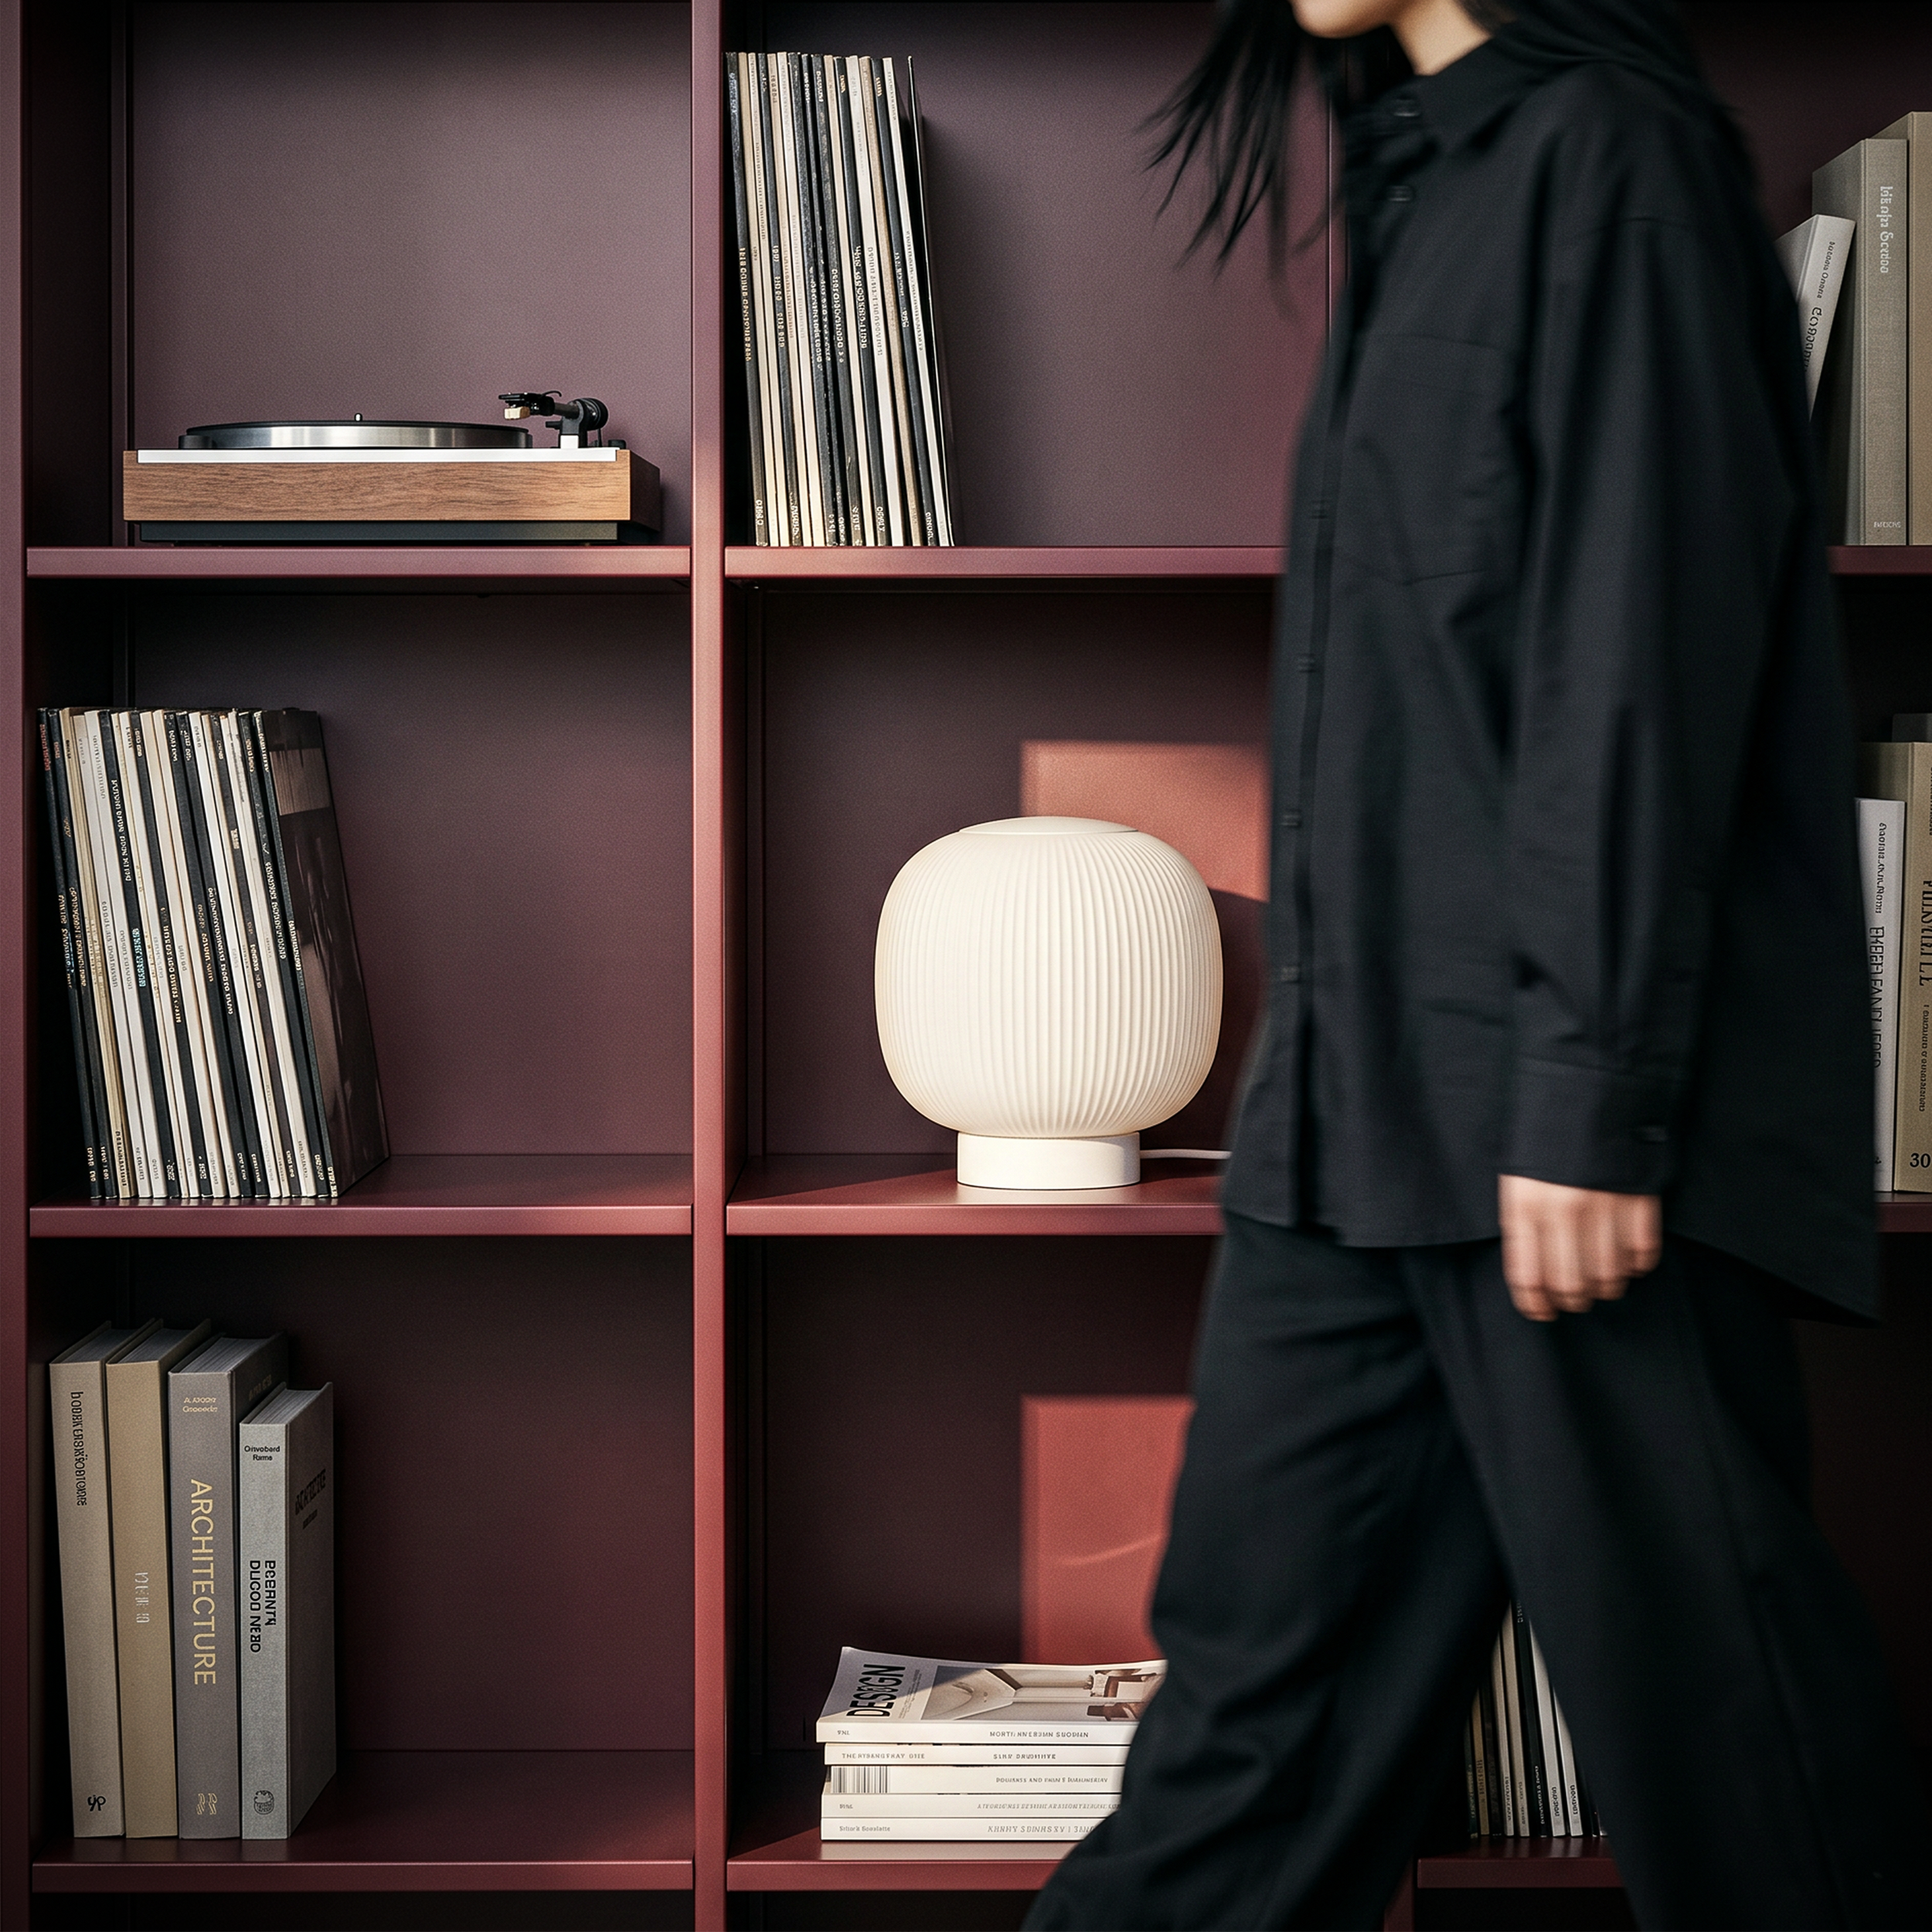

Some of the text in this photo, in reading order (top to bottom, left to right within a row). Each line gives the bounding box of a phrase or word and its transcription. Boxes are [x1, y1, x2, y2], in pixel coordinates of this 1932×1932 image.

[1909, 1152, 1931, 1168] 30
[188, 1478, 217, 1685] ARCHITECTURE
[845, 1664, 906, 1718] DESIGN
